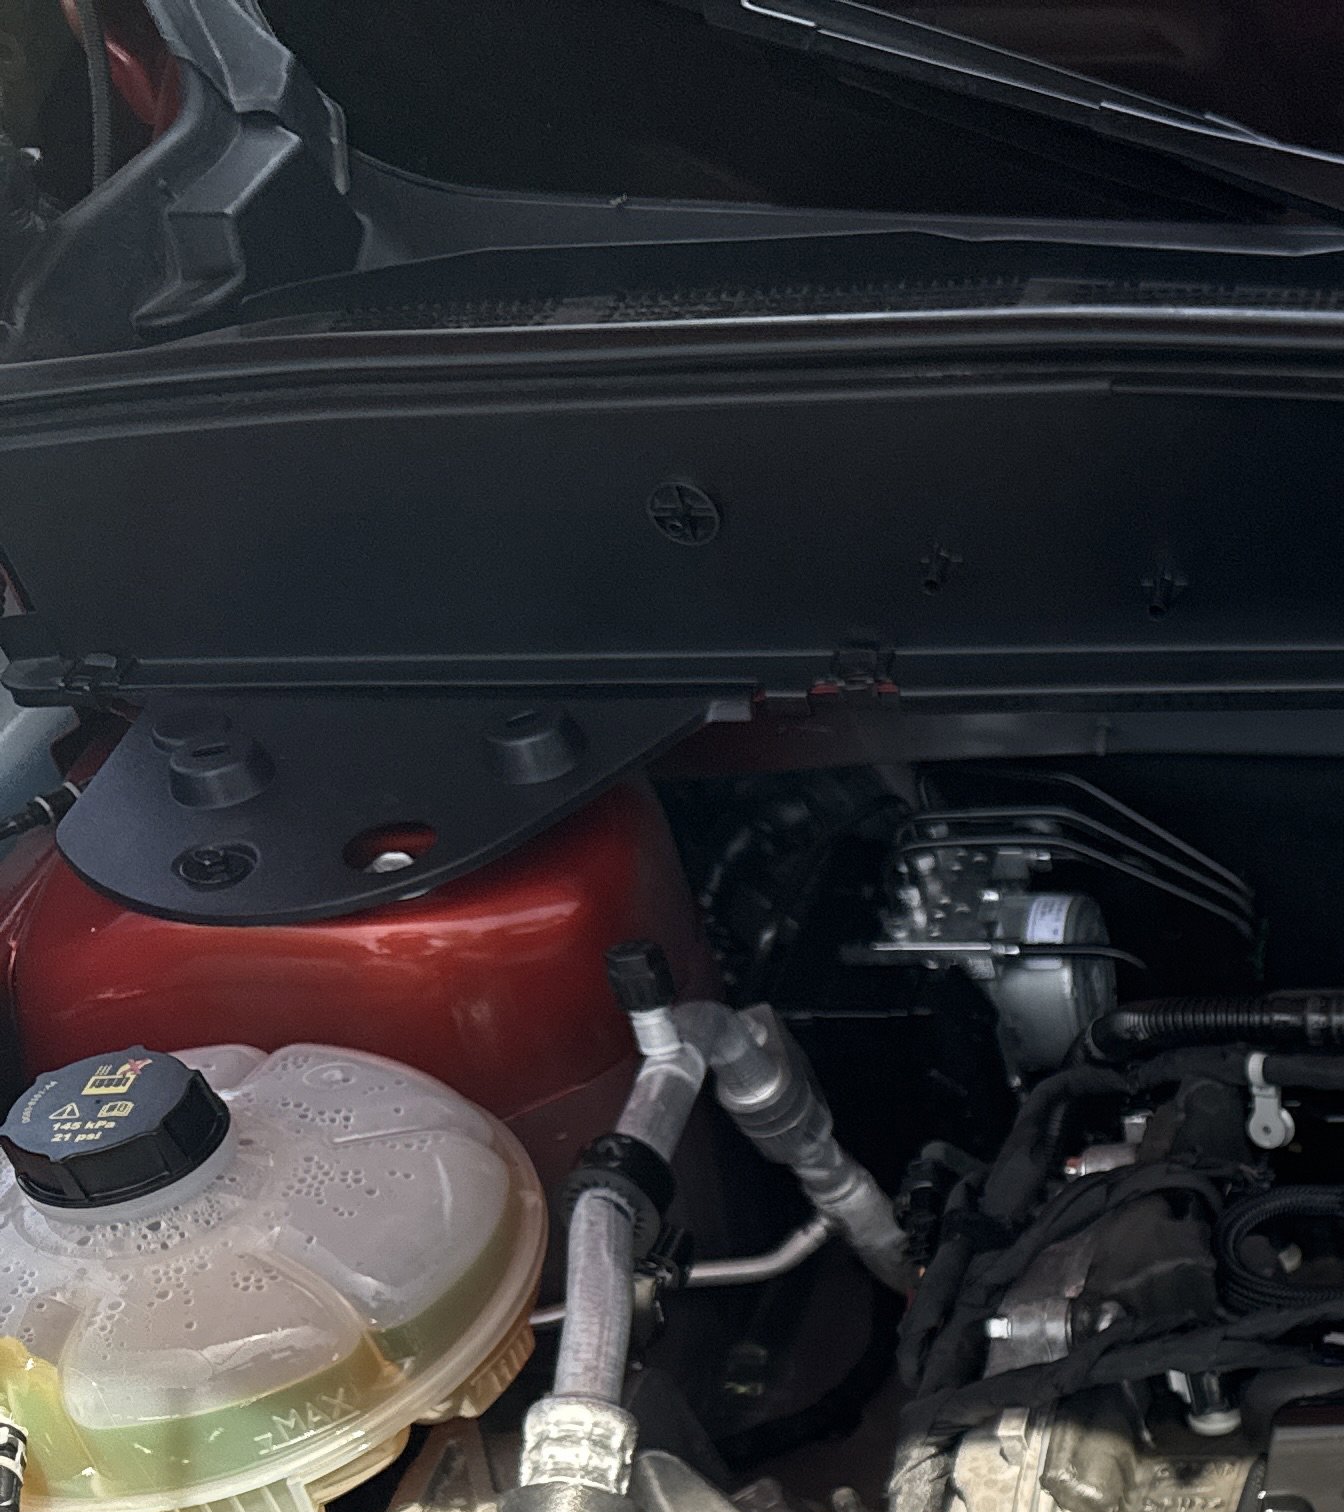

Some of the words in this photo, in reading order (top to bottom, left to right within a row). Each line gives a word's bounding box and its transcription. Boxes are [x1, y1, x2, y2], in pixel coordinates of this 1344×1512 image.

[52, 1121, 83, 1131] 145
[84, 1119, 117, 1130] kPa
[51, 1132, 70, 1142] 21
[74, 1131, 103, 1143] psi
[271, 1387, 356, 1441] MAX
